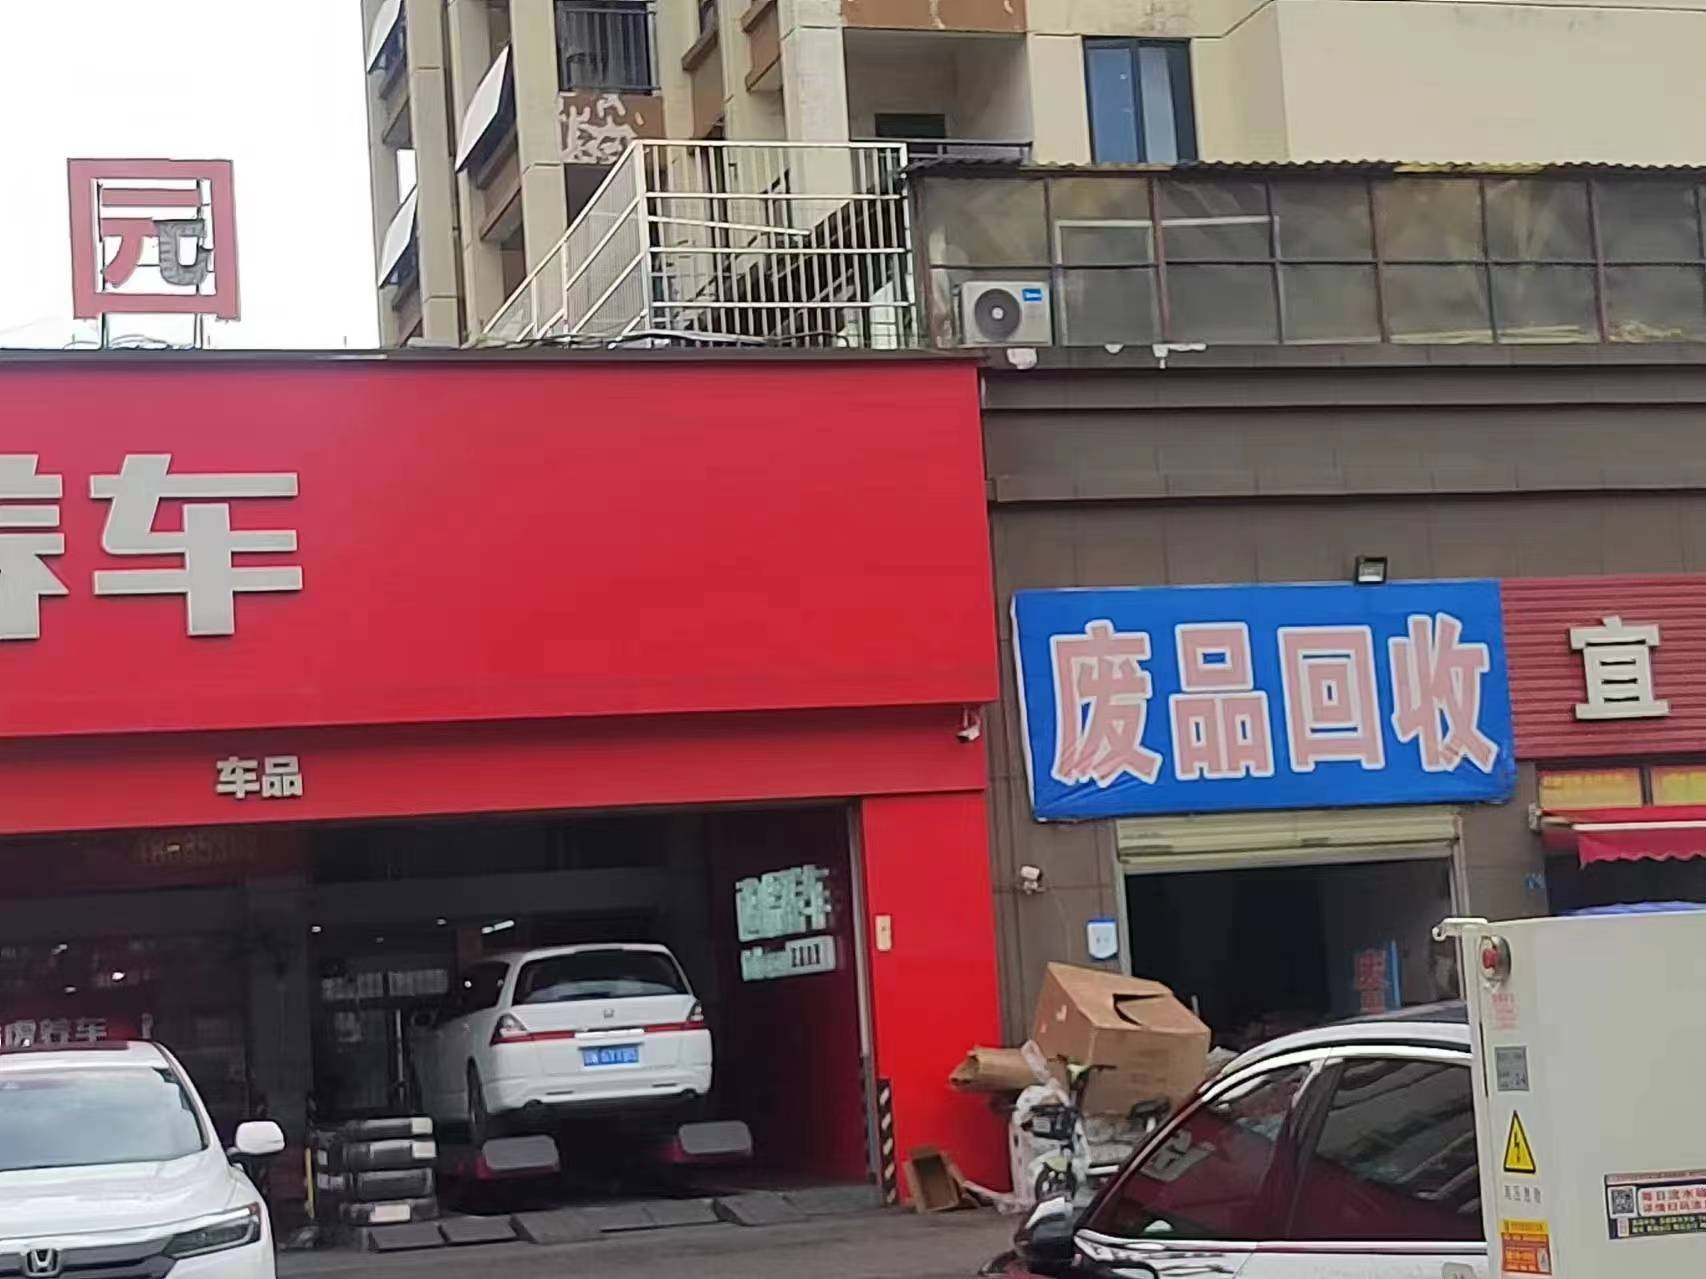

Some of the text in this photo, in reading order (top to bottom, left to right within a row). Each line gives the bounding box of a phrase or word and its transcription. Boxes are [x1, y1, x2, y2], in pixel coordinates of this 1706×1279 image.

[67, 158, 240, 322] 园
[1049, 614, 1499, 787] 废品回收
[1568, 614, 1670, 721] 宜
[216, 757, 303, 800] 车品
